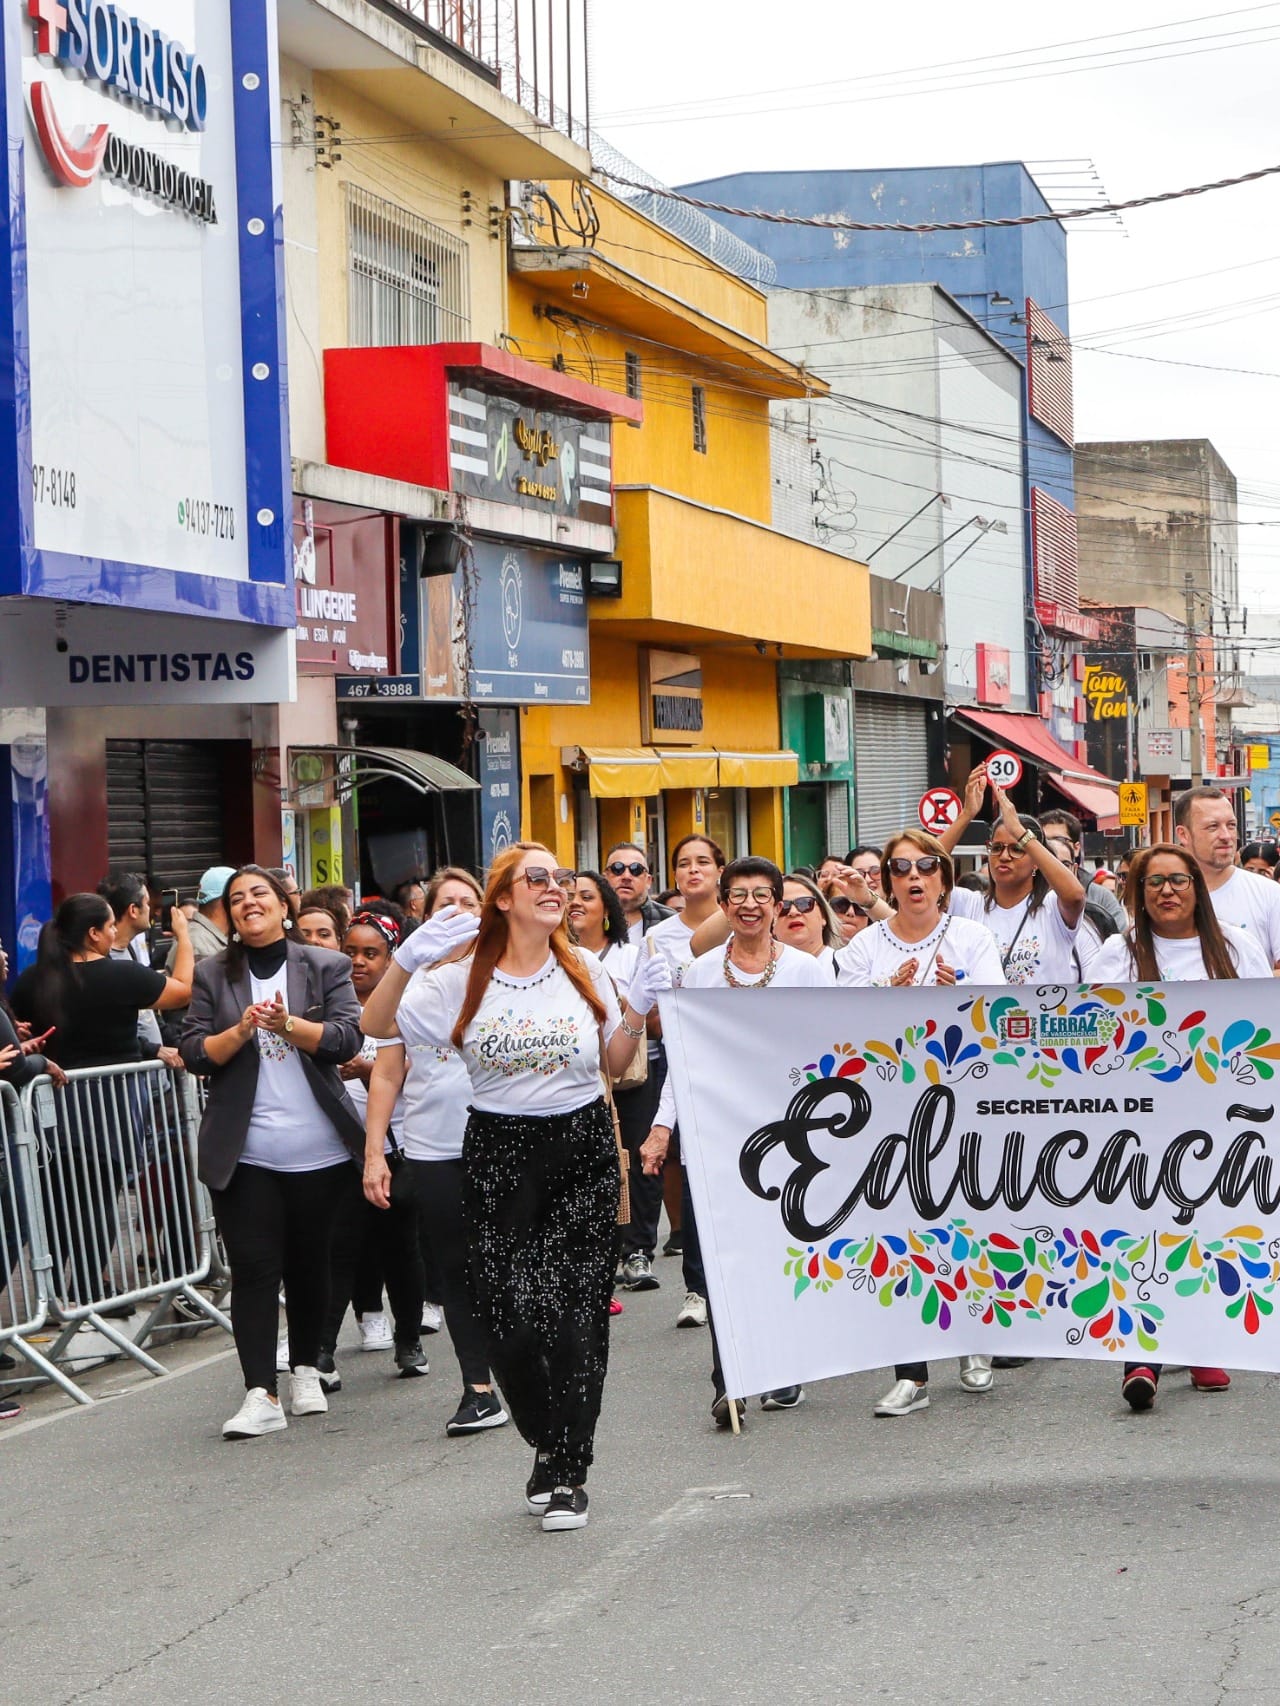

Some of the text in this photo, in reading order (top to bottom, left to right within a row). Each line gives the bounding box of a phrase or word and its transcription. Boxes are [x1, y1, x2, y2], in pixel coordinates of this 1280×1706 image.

[67, 0, 208, 132] SORRISO
[103, 132, 218, 224] ODONTOLOGIA
[32, 464, 76, 509] 97-8148
[185, 498, 235, 540] 94137-7278
[301, 588, 357, 622] LINGERIE
[68, 652, 255, 683] DENTISTAS
[1082, 665, 1126, 695] Tom
[347, 683, 413, 697] 467-3988
[991, 760, 1015, 776] 30
[1040, 1012, 1098, 1032] FERRAZ
[480, 1030, 571, 1058] Educação
[1039, 1037, 1099, 1047] CIDADE DA UVA
[976, 1097, 1154, 1115] SECRETARIA DE
